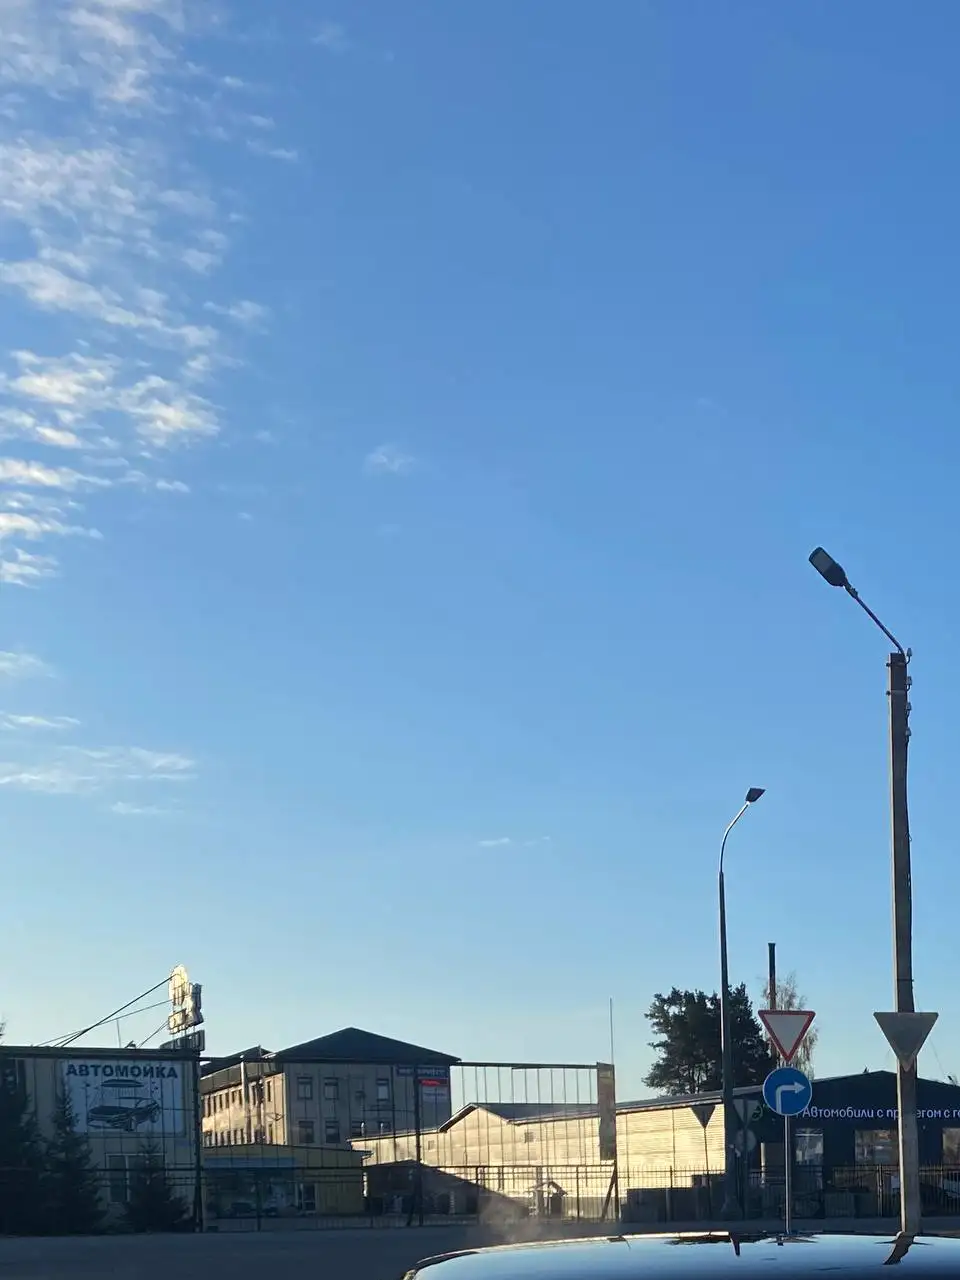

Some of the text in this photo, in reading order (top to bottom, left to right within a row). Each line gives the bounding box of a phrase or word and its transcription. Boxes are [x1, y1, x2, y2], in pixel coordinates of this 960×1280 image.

[66, 1063, 178, 1079] АВТОМОЙКА
[802, 1106, 874, 1119] Автомобили
[876, 1108, 884, 1119] с
[886, 1108, 942, 1122] прегом
[943, 1108, 951, 1119] с
